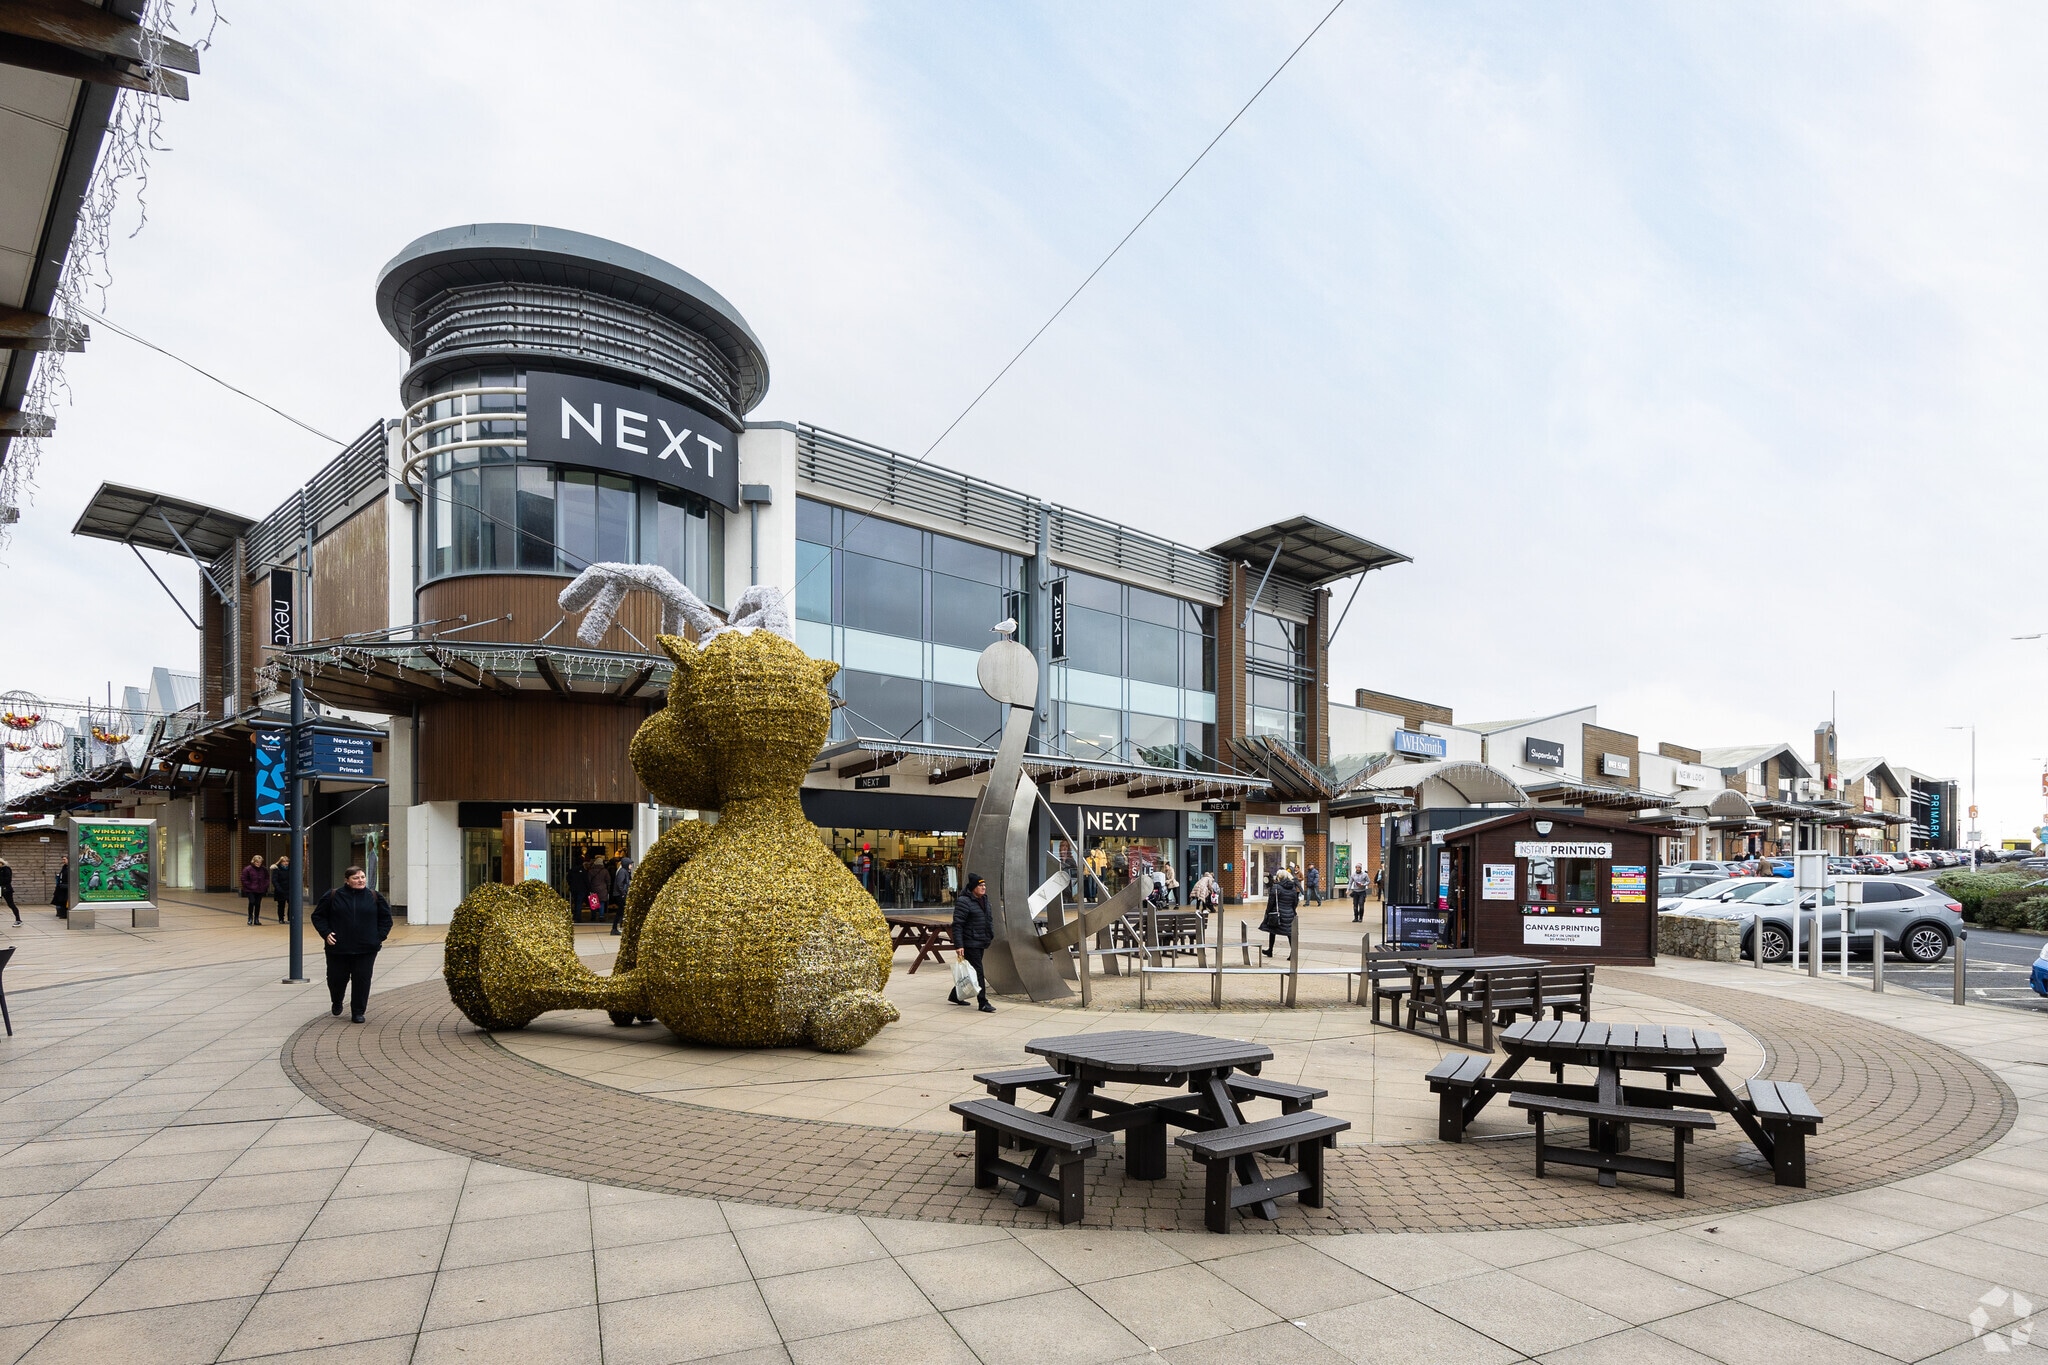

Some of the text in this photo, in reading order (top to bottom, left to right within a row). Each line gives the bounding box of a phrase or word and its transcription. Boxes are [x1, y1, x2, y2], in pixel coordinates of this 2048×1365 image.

[561, 397, 723, 478] NEXT
[274, 600, 291, 643] next
[1054, 594, 1062, 646] NEXT
[348, 738, 364, 746] Look
[1401, 734, 1443, 755] WHSmith
[1679, 770, 1691, 779] NEW
[863, 778, 880, 787] NEXT
[1287, 804, 1311, 813] claire's
[1086, 810, 1140, 832] NEXT
[1930, 794, 1940, 838] PRIMARK
[1253, 826, 1284, 840] claire's
[1520, 845, 1606, 855] INSTANT PRINTING
[1525, 923, 1560, 931] CANVAS
